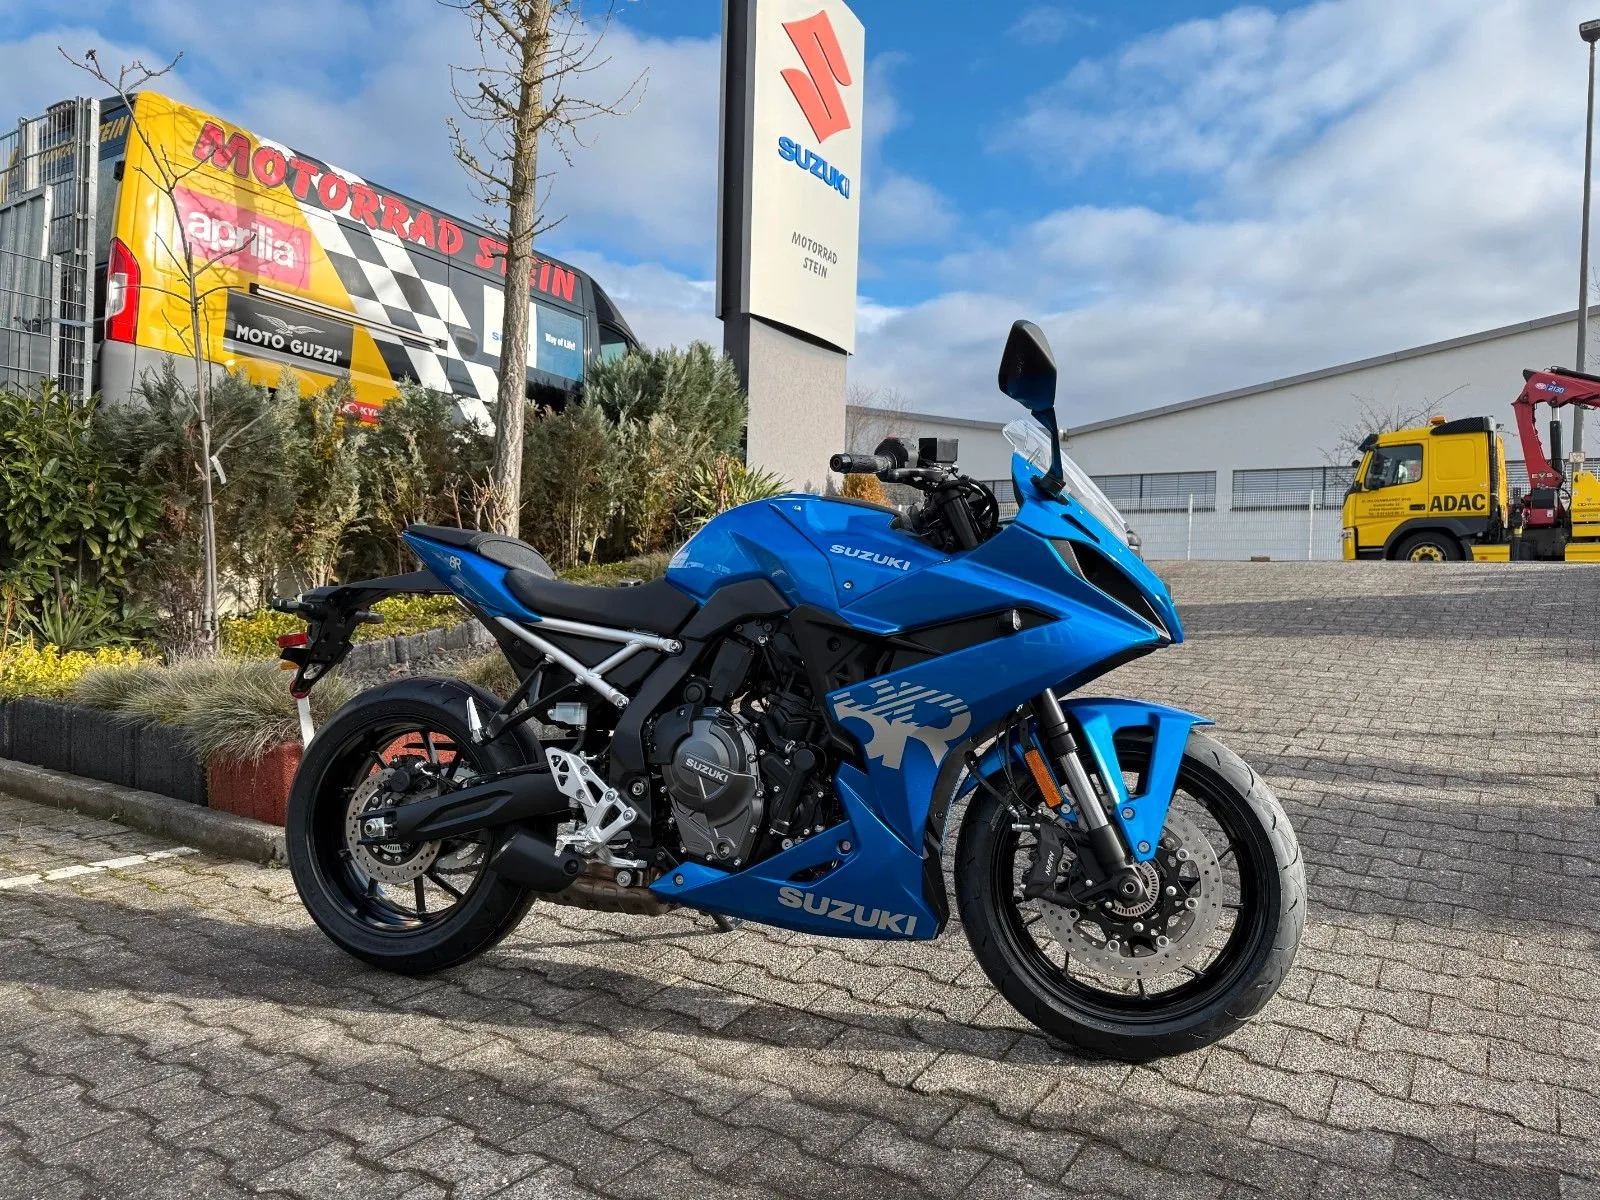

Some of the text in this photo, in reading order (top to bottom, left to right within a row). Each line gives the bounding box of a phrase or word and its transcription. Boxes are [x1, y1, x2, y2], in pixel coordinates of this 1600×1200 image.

[778, 136, 850, 199] SUZUKI
[192, 121, 464, 255] MOTORRAD
[188, 211, 294, 269] aprilia
[791, 231, 838, 265] MOTORRAD
[803, 257, 828, 279] STEIN
[236, 324, 339, 363] MOTO GUZZI
[545, 332, 557, 346] Way
[1430, 493, 1486, 511] ADAC
[449, 555, 462, 571] 8R
[829, 544, 911, 572] SUZUKI
[685, 757, 729, 784] SUZUKI
[777, 886, 918, 936] SUZUKI
